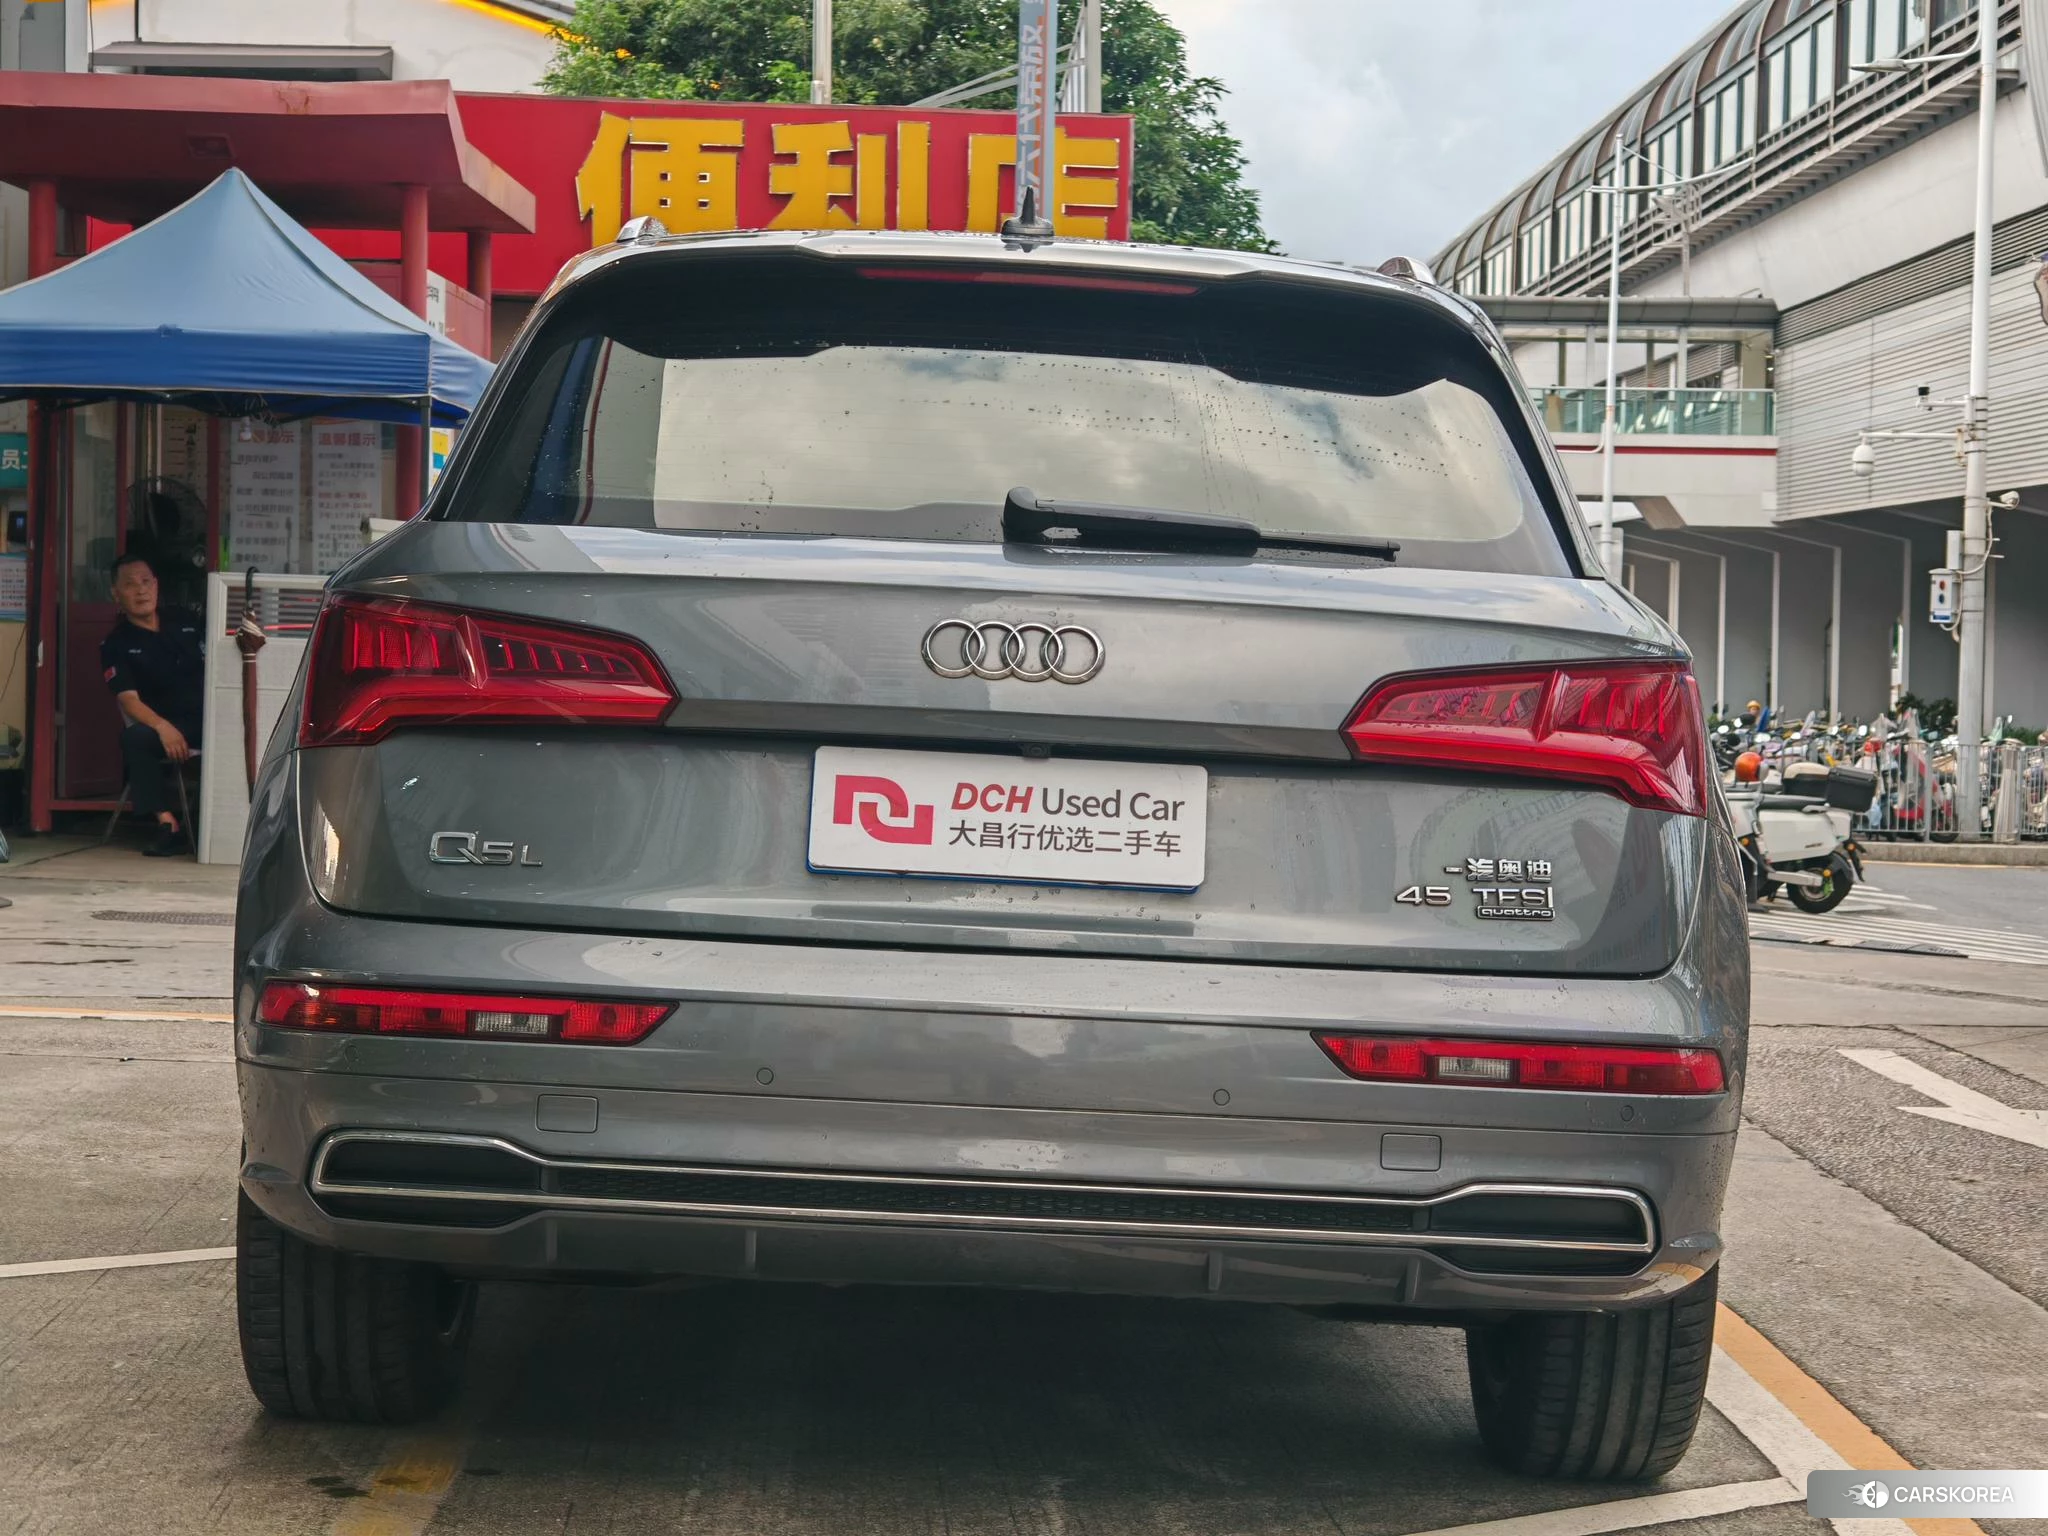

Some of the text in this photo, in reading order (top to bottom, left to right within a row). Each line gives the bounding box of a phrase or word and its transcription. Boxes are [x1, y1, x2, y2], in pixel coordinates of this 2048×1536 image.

[2, 449, 28, 470] 员
[951, 782, 1185, 821] DCH Used Car
[948, 820, 1182, 858] 大昌行优选二手车
[1396, 885, 1554, 908] 45 TFSI
[1480, 907, 1552, 918] quattro
